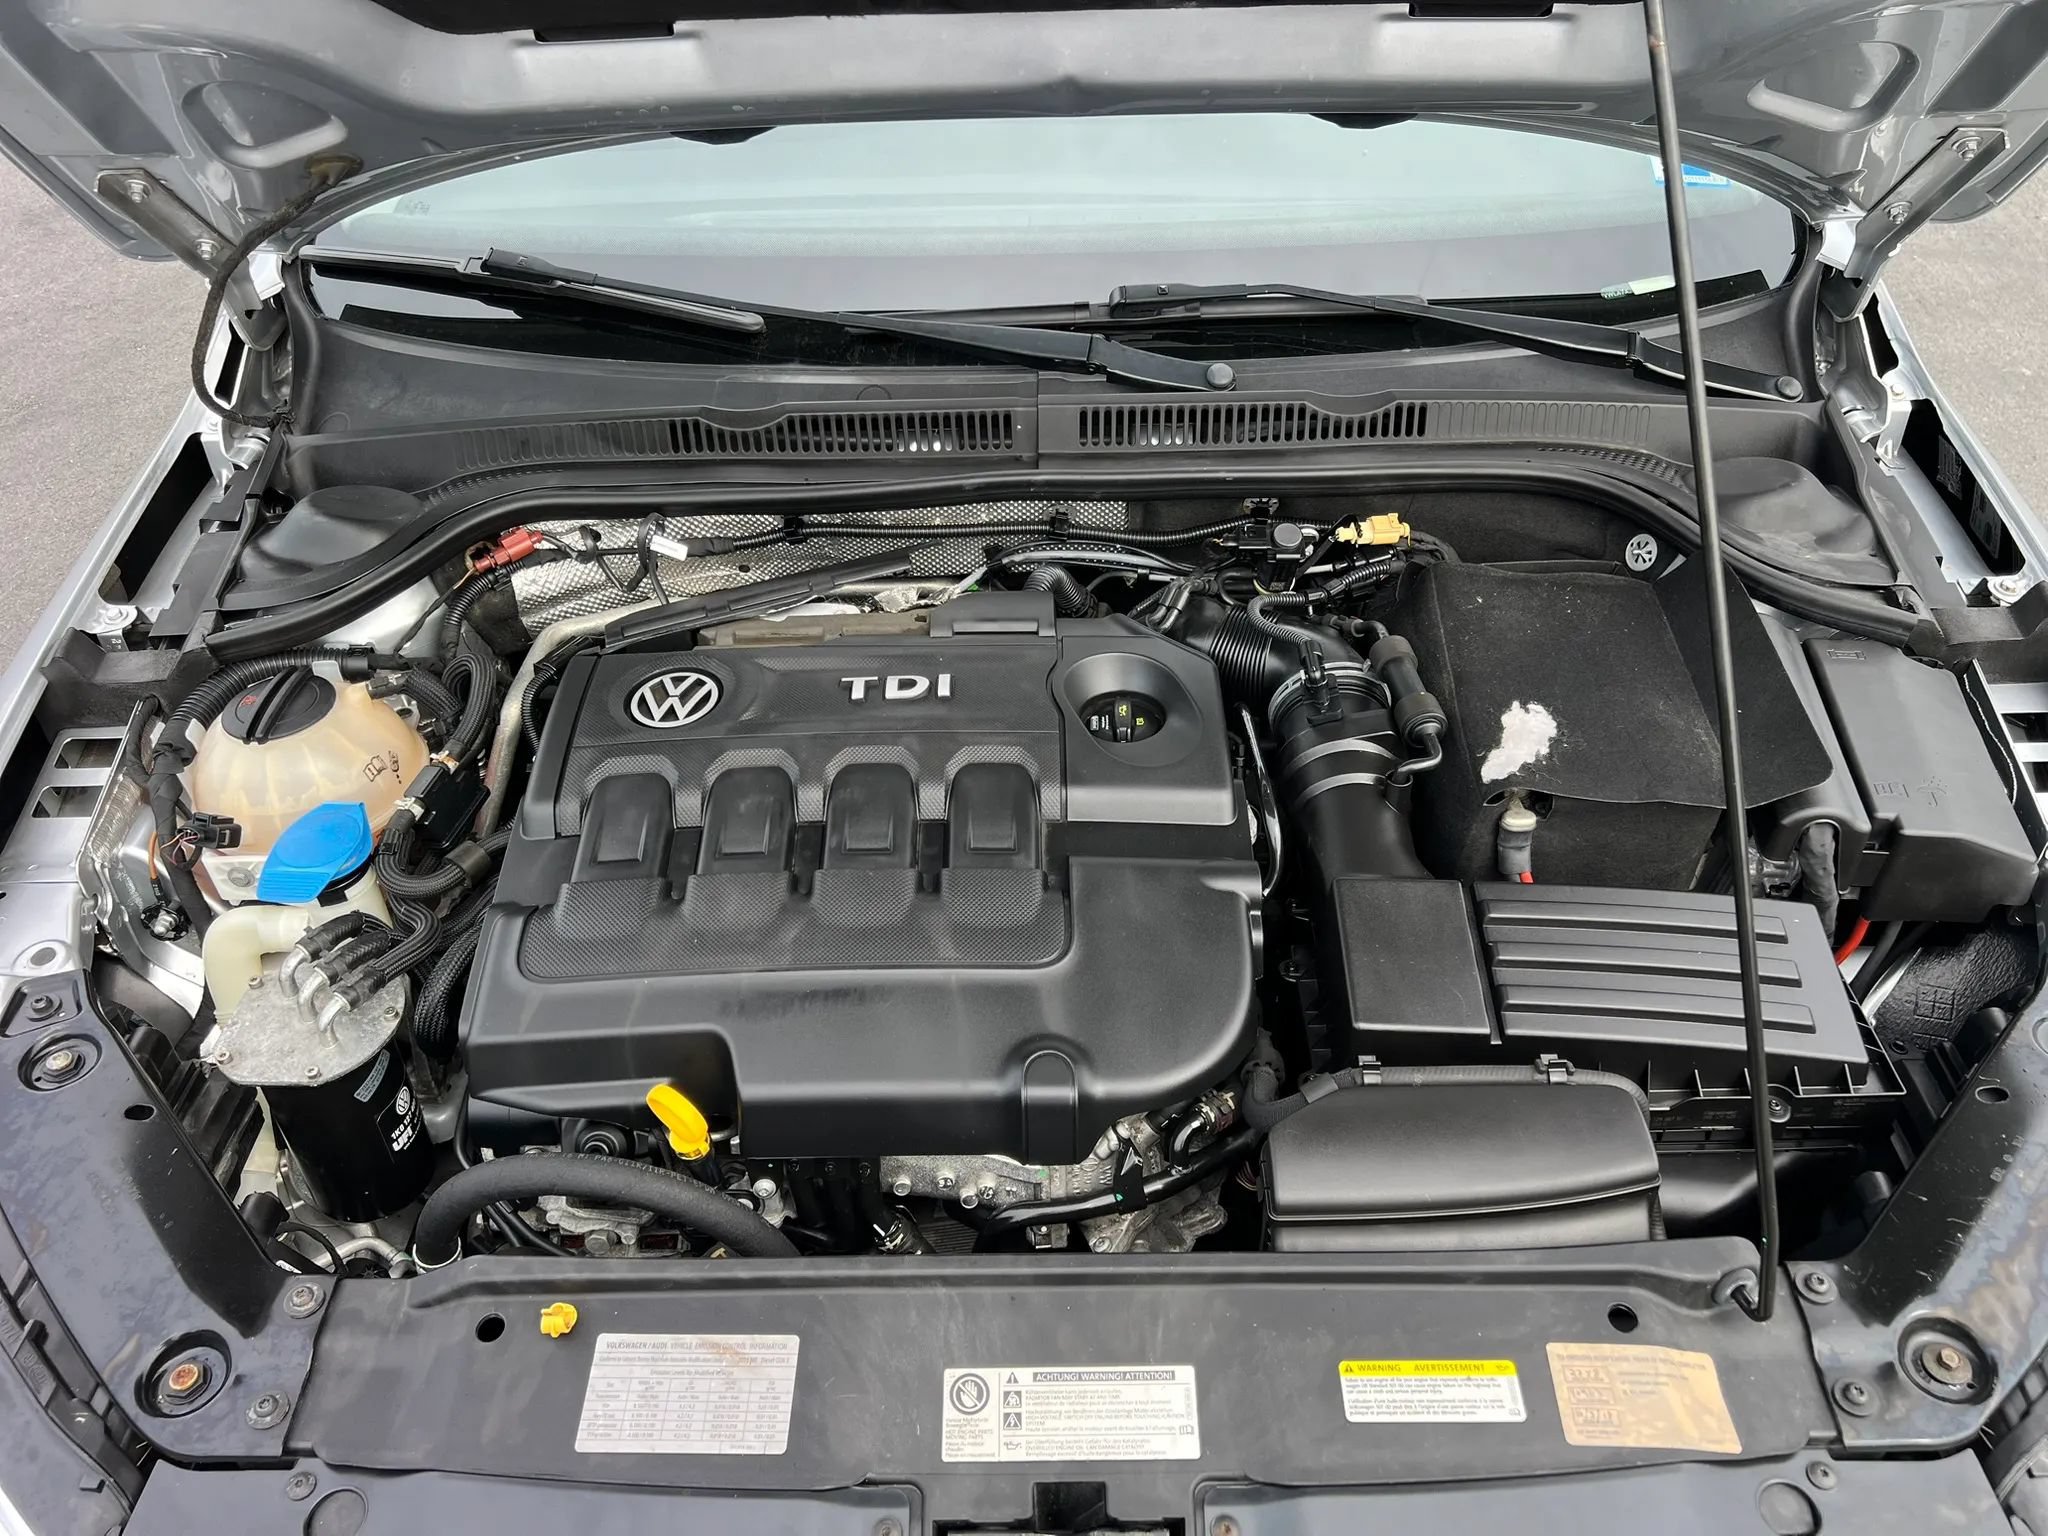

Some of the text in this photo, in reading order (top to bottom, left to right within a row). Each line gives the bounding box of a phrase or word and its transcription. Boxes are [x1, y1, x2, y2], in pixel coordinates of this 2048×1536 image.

[841, 674, 952, 700] TDI
[671, 1342, 693, 1350] VEHICLE
[749, 1343, 788, 1351] INFORMATION
[1357, 1363, 1486, 1372] WARNING AVERTISSEMENT
[1036, 1370, 1173, 1382] ACHTUNG! WARNING! ATTENTION!
